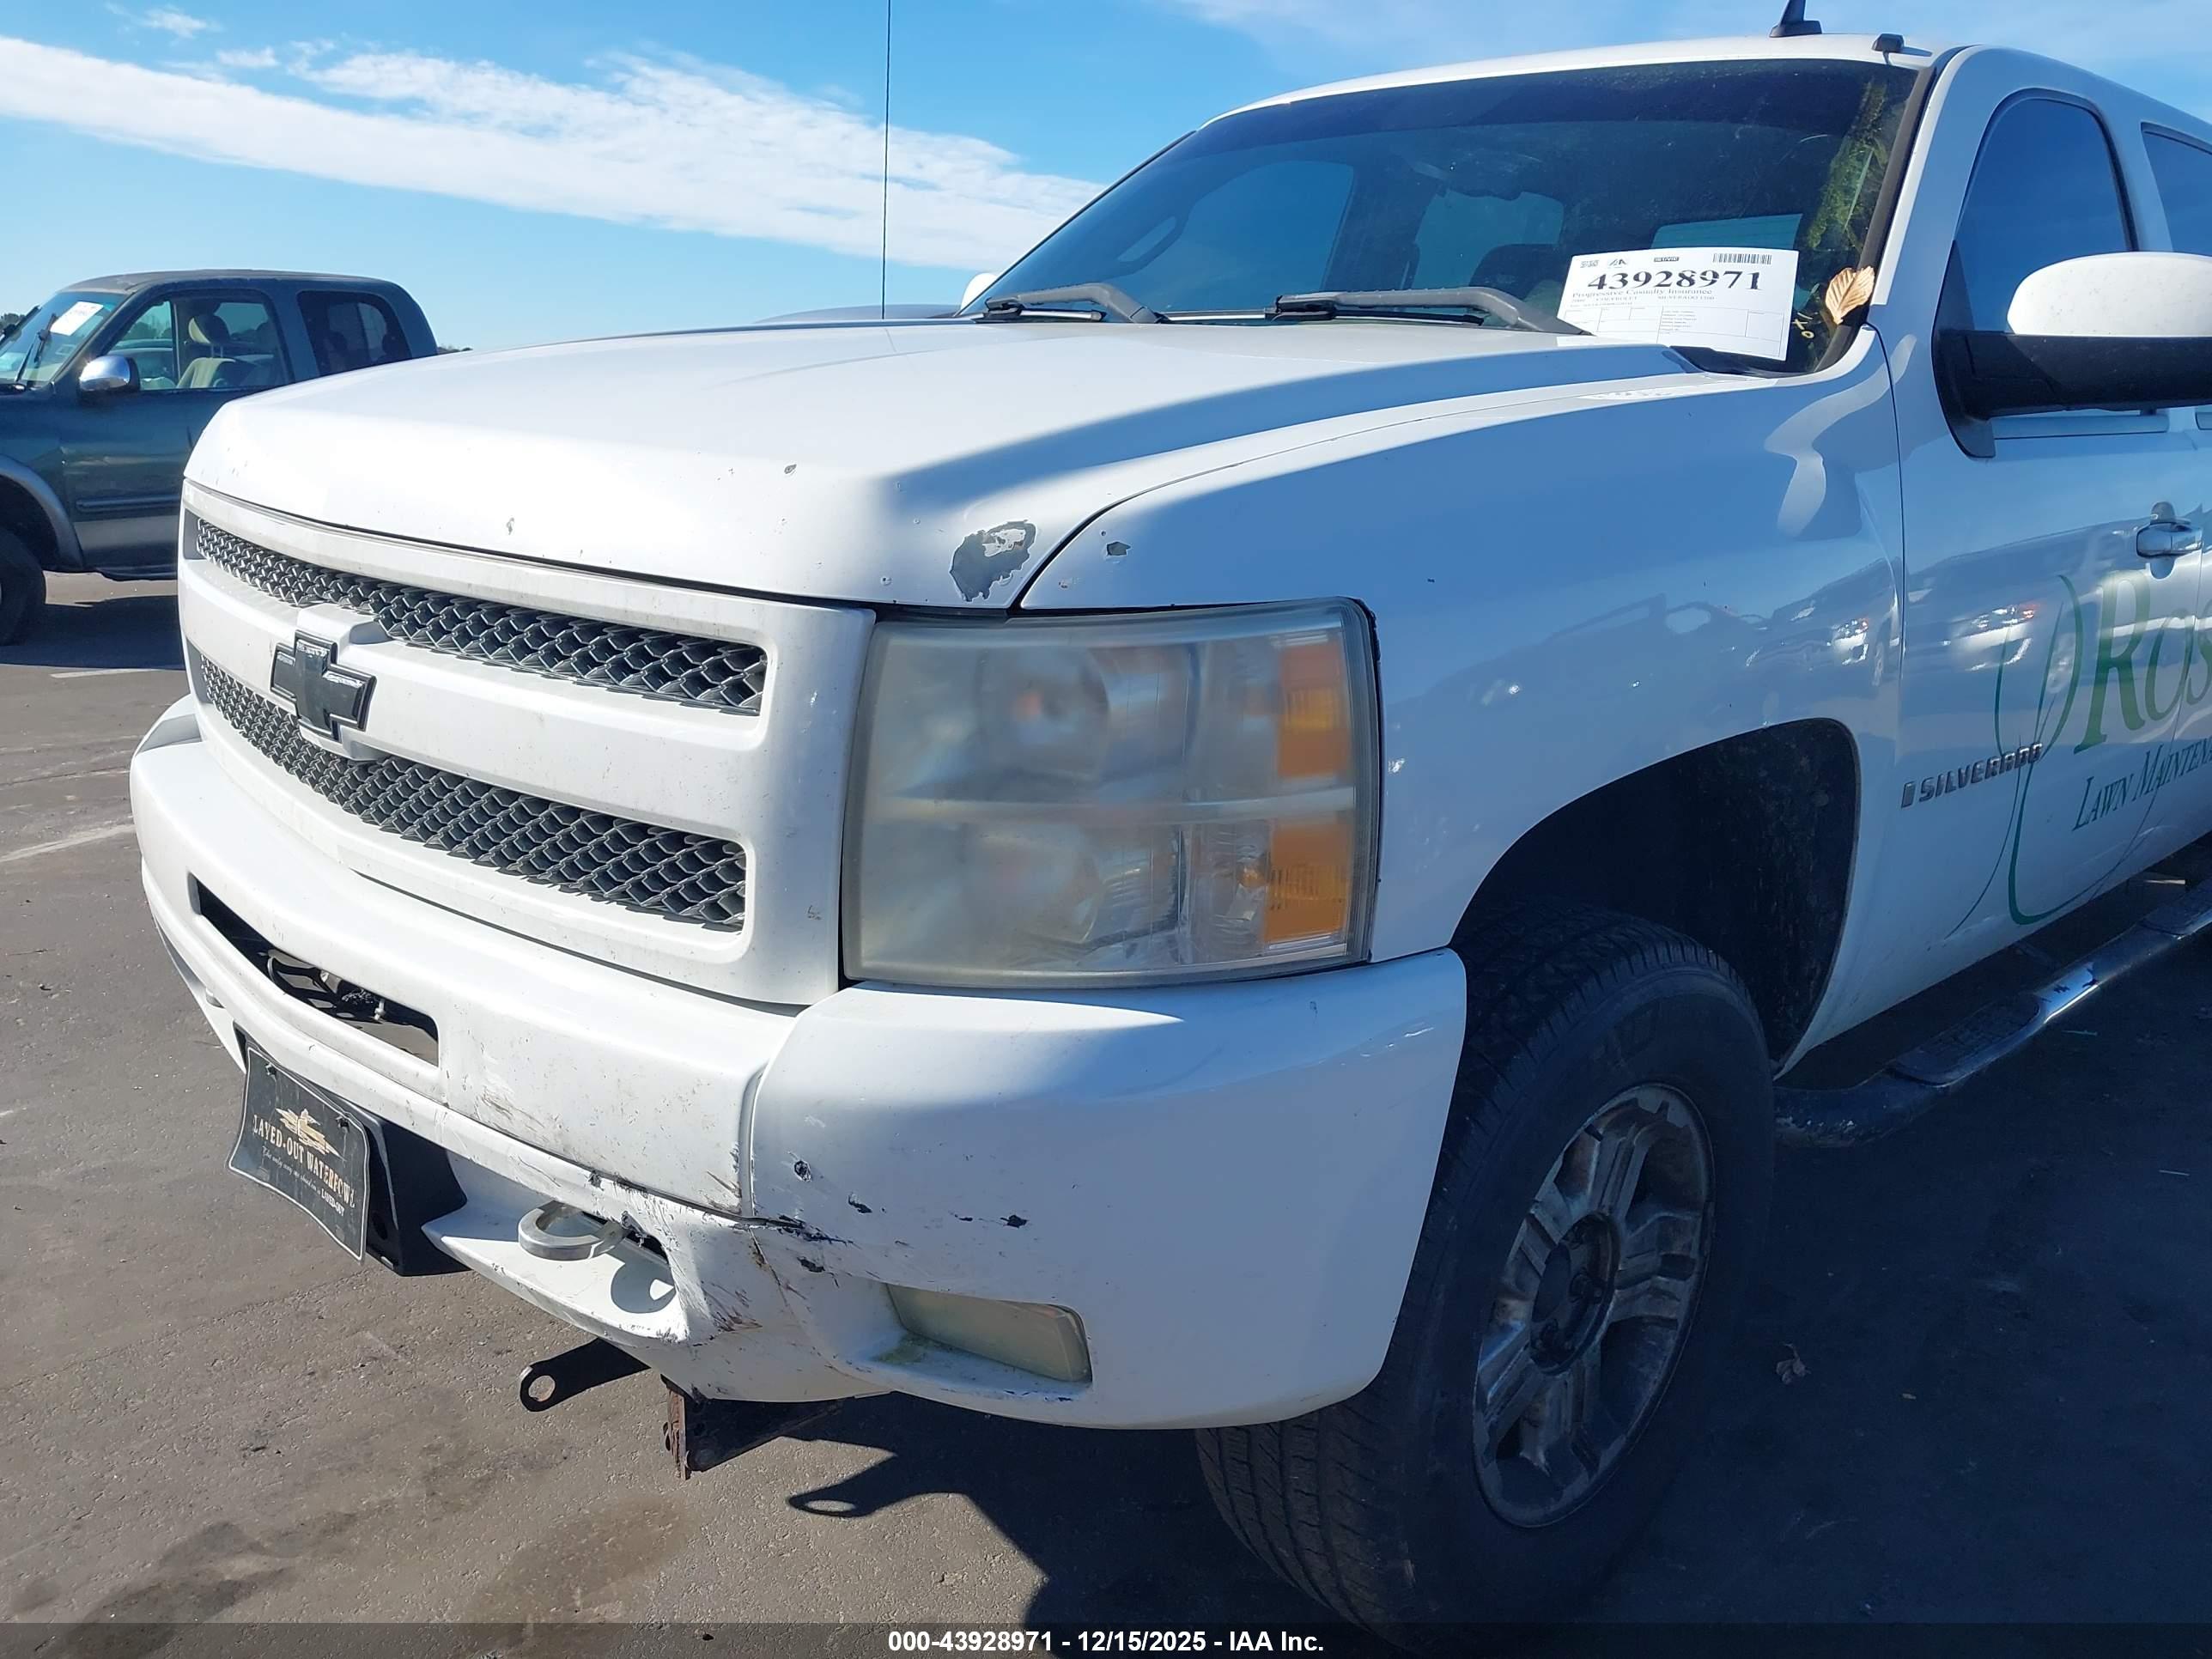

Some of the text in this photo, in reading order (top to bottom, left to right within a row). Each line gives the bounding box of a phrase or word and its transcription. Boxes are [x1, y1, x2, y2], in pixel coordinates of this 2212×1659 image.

[1587, 270, 1762, 291] 43928971
[1918, 741, 2043, 803] SILVERADO
[252, 1114, 356, 1208] LAYED-OUT WATERFOWL
